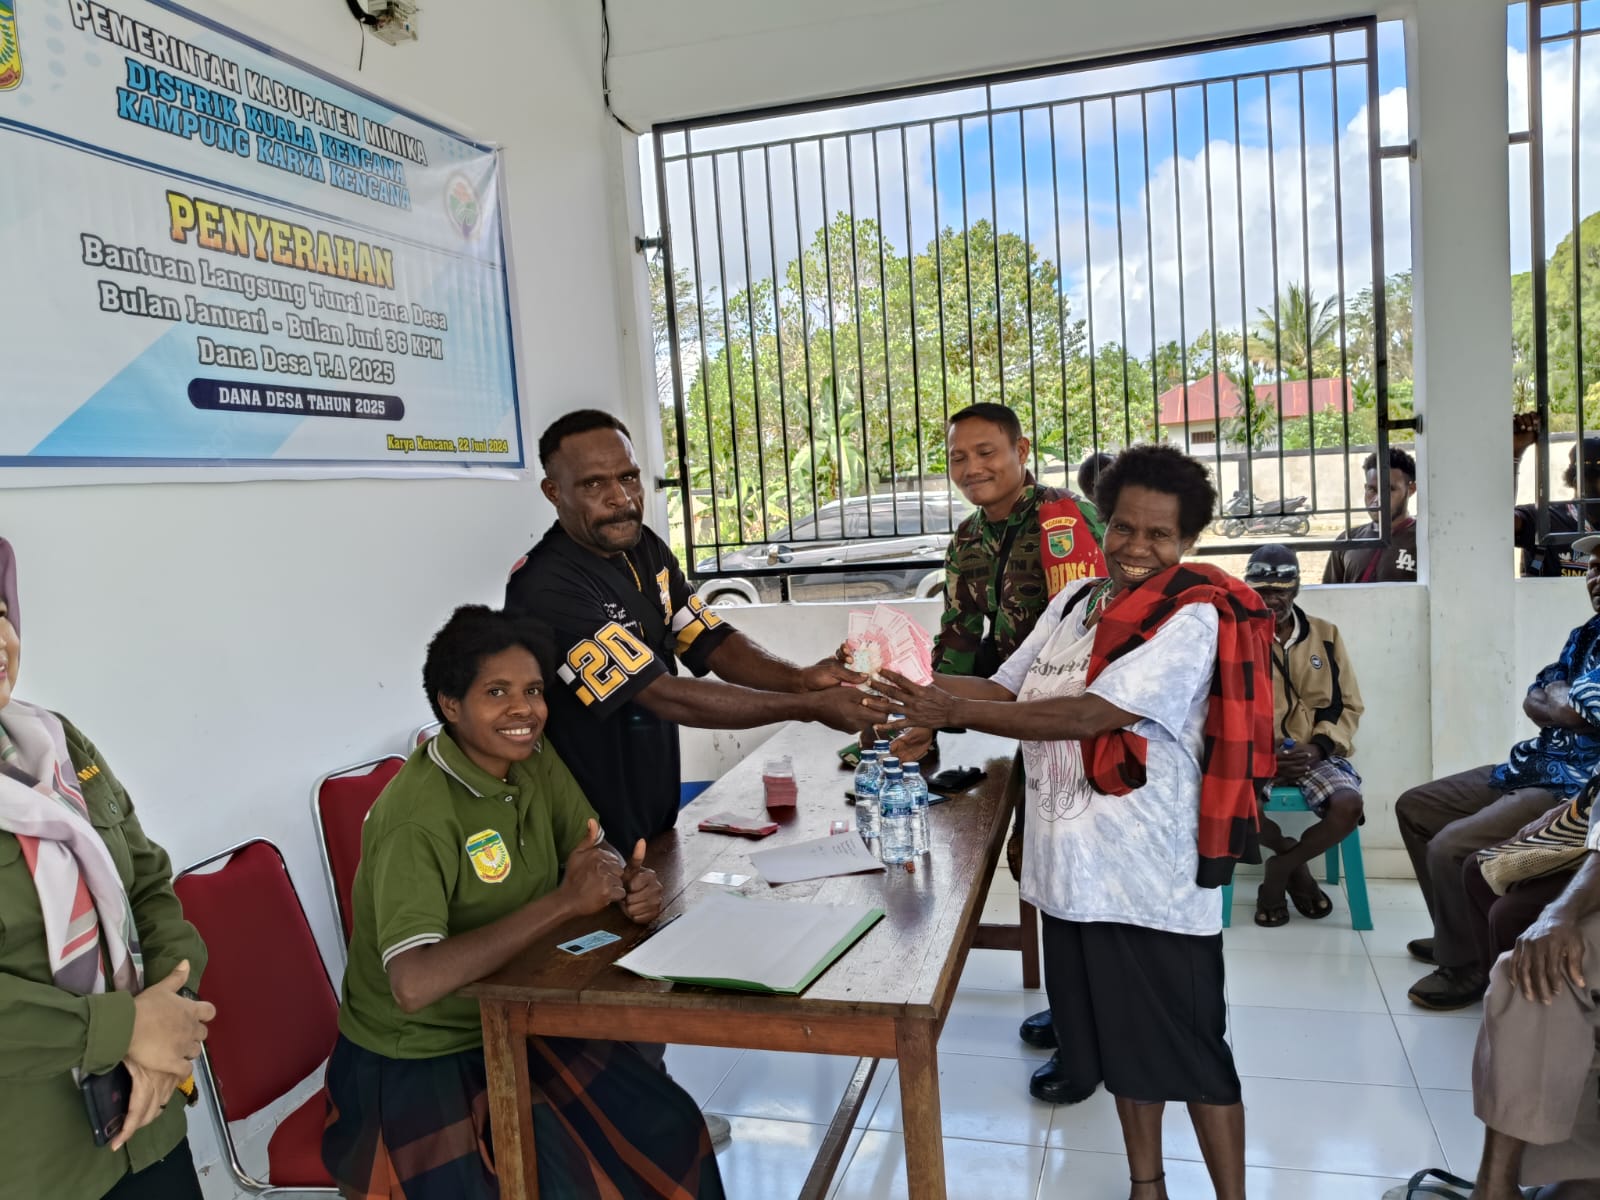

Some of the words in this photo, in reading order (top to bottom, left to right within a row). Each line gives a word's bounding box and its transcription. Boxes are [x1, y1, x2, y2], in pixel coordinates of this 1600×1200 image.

[69, 0, 242, 95] PEMERINTAH
[245, 69, 360, 140] KABUPATEN
[363, 117, 428, 166] MIMIKA
[125, 57, 240, 126] DISTRIK
[242, 103, 317, 154] KUALA
[320, 132, 407, 186] KENCANA
[116, 86, 250, 158] KAMPUNG
[256, 135, 325, 183] KARYA
[329, 161, 412, 212] KENCANA
[166, 190, 395, 289] PENYERAHAN
[80, 233, 196, 284] Bantuan
[200, 258, 306, 310] Langsung
[309, 282, 364, 316] Tunai
[366, 293, 410, 324] Dana
[412, 303, 448, 331] Desa
[98, 280, 181, 321] Bulan
[185, 295, 269, 334] Januari
[272, 321, 283, 331] -
[286, 312, 345, 346] Bulan
[346, 323, 384, 351] Juni
[386, 330, 408, 354] 36
[411, 334, 444, 360] KPM
[197, 336, 258, 370] Dana
[261, 345, 313, 377] Desa
[314, 352, 348, 379] T.A
[350, 356, 396, 385] 2025
[218, 386, 263, 407] DANA
[266, 391, 304, 410] DESA
[307, 394, 352, 413] TAHUN
[355, 398, 387, 415] 2025
[387, 434, 416, 454] Karya
[416, 435, 457, 453] Kencana,
[458, 437, 470, 452] 22
[471, 438, 488, 453] Juni
[1395, 548, 1415, 571] LA
[567, 620, 655, 702] 20
